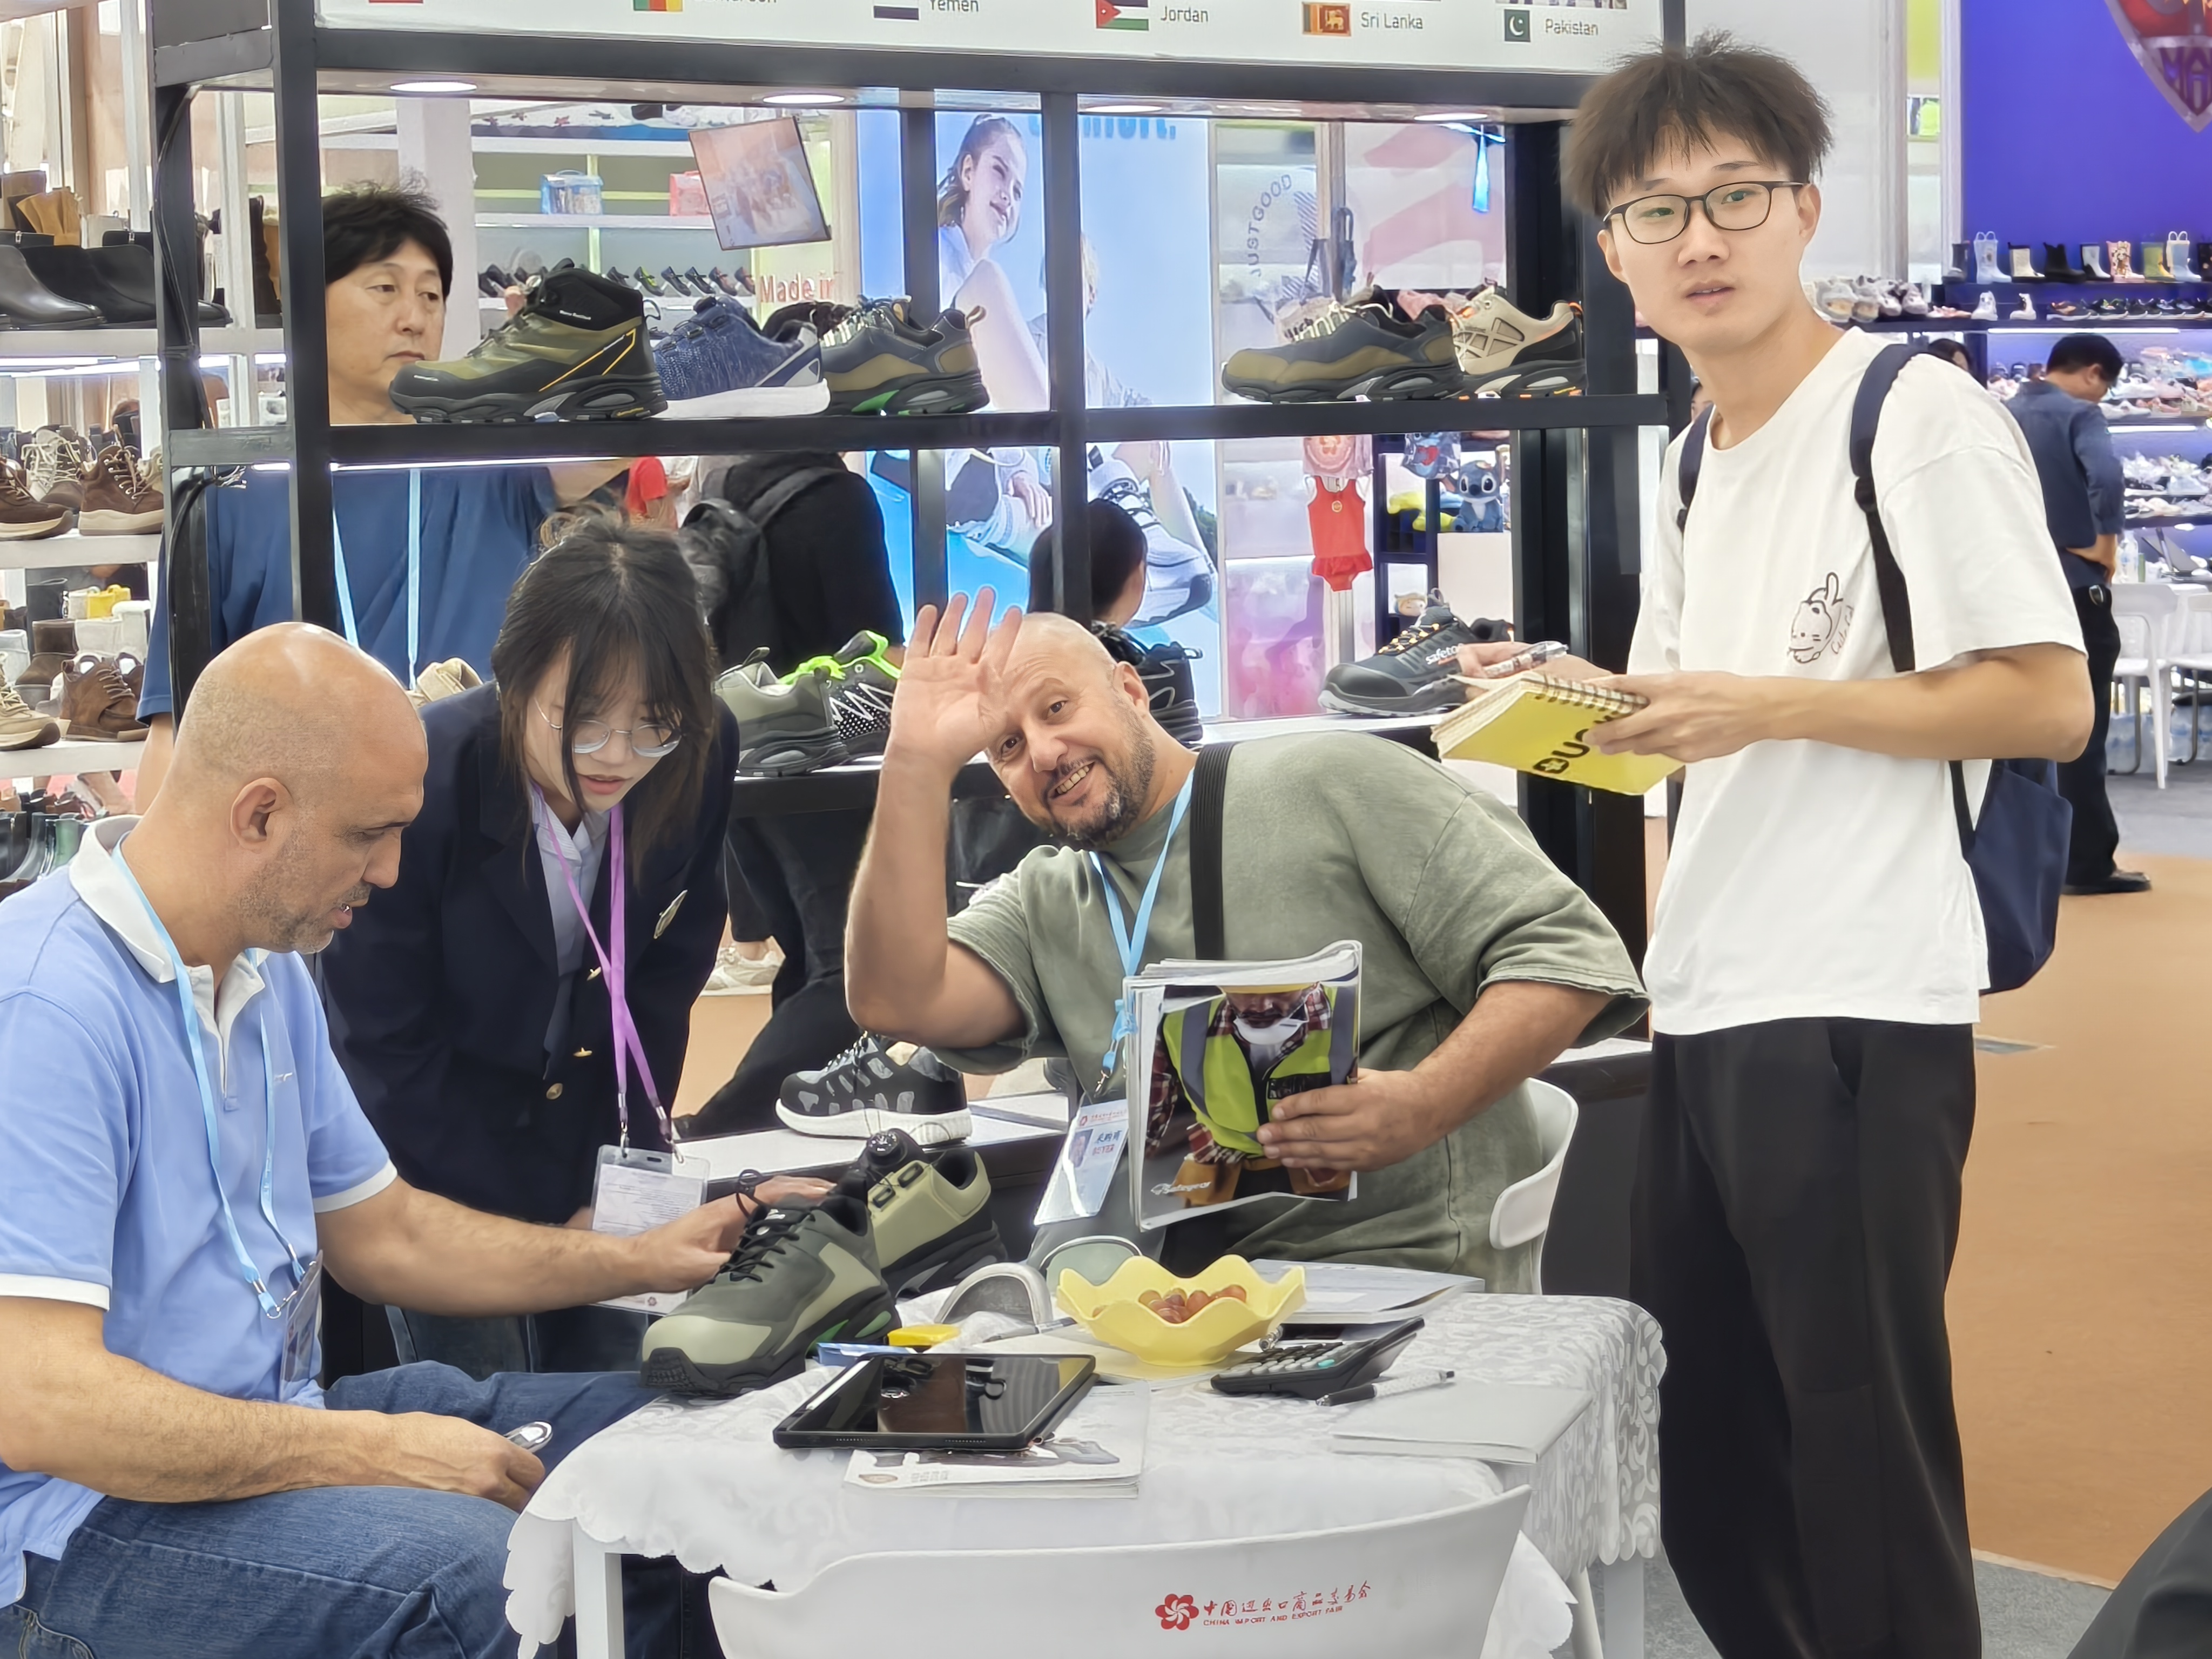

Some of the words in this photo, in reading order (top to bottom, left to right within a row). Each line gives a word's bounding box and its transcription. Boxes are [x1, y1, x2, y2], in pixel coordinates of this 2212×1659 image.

[1160, 6, 1209, 23] Jordan
[1360, 12, 1380, 29] Sri
[1384, 14, 1424, 30] Lanka
[1545, 18, 1599, 36] Pakistan
[760, 272, 814, 302] Made
